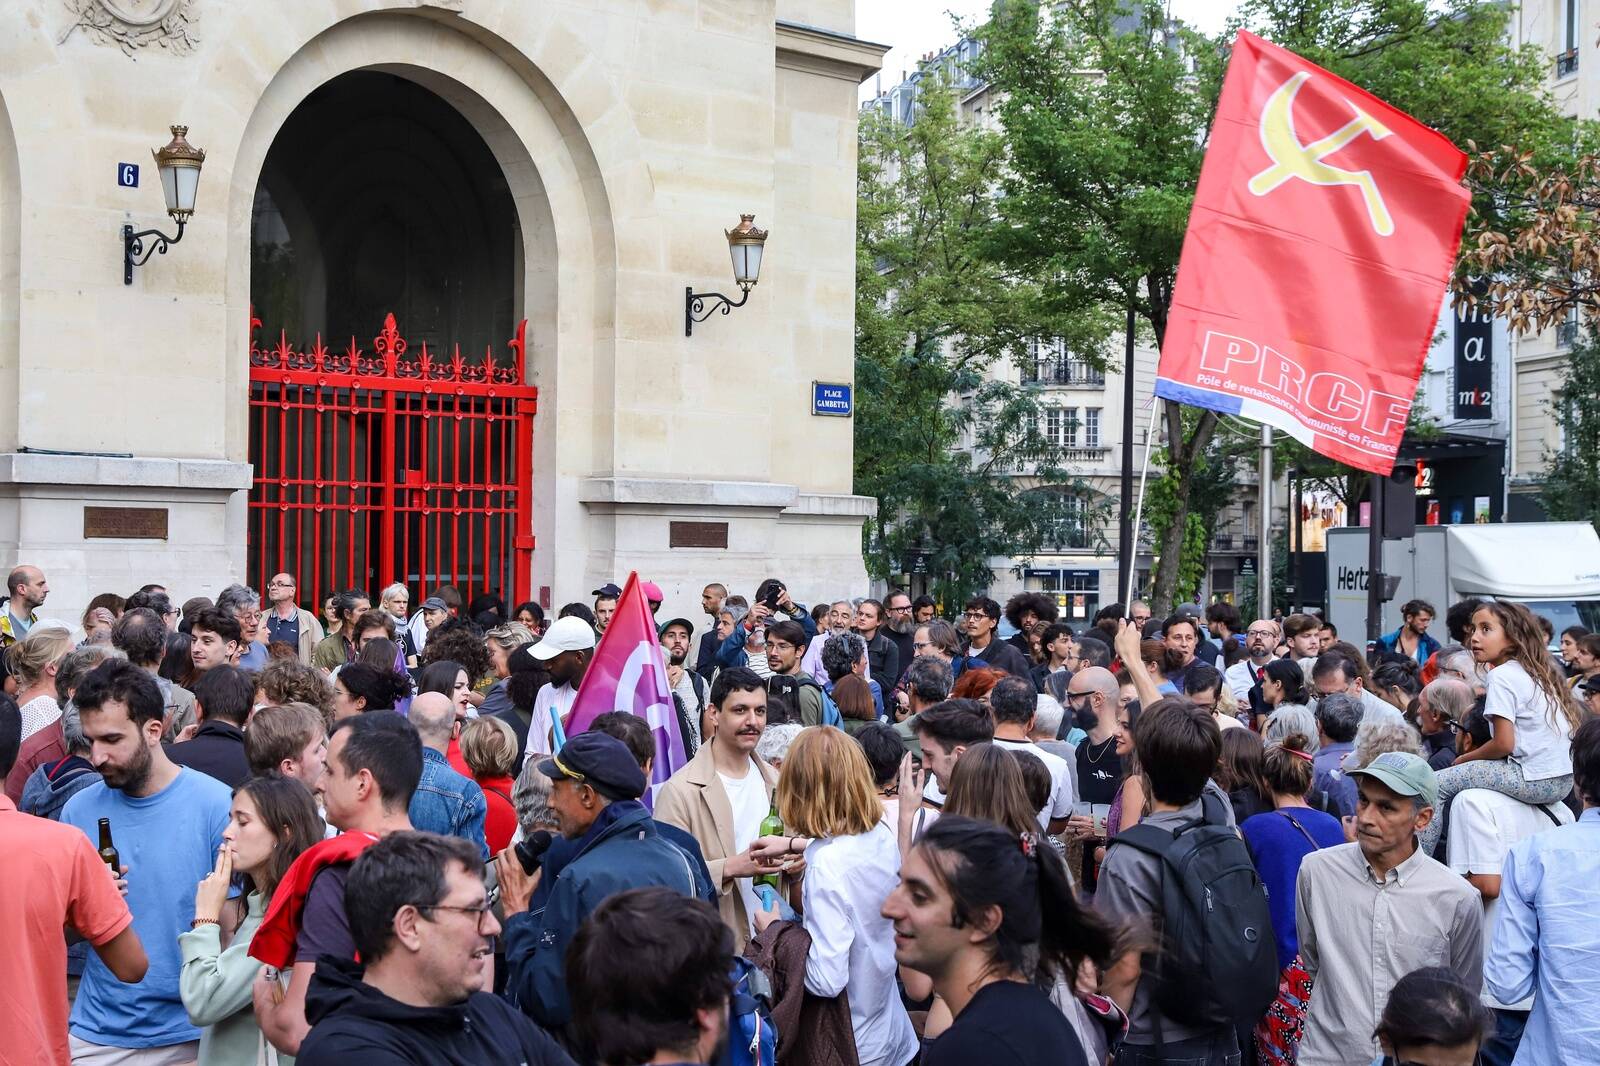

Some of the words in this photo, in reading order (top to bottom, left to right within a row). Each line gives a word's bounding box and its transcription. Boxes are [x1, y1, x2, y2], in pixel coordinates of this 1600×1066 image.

[123, 165, 134, 185] 6
[824, 389, 842, 398] PLACE
[1199, 330, 1413, 436] PRCF
[816, 400, 849, 409] GAMBETTA
[1196, 373, 1221, 387] Pôle
[1223, 380, 1238, 391] de
[1239, 385, 1294, 411] renaissance
[1348, 432, 1361, 442] en
[1361, 435, 1398, 454] France
[1337, 566, 1369, 590] Hertz
